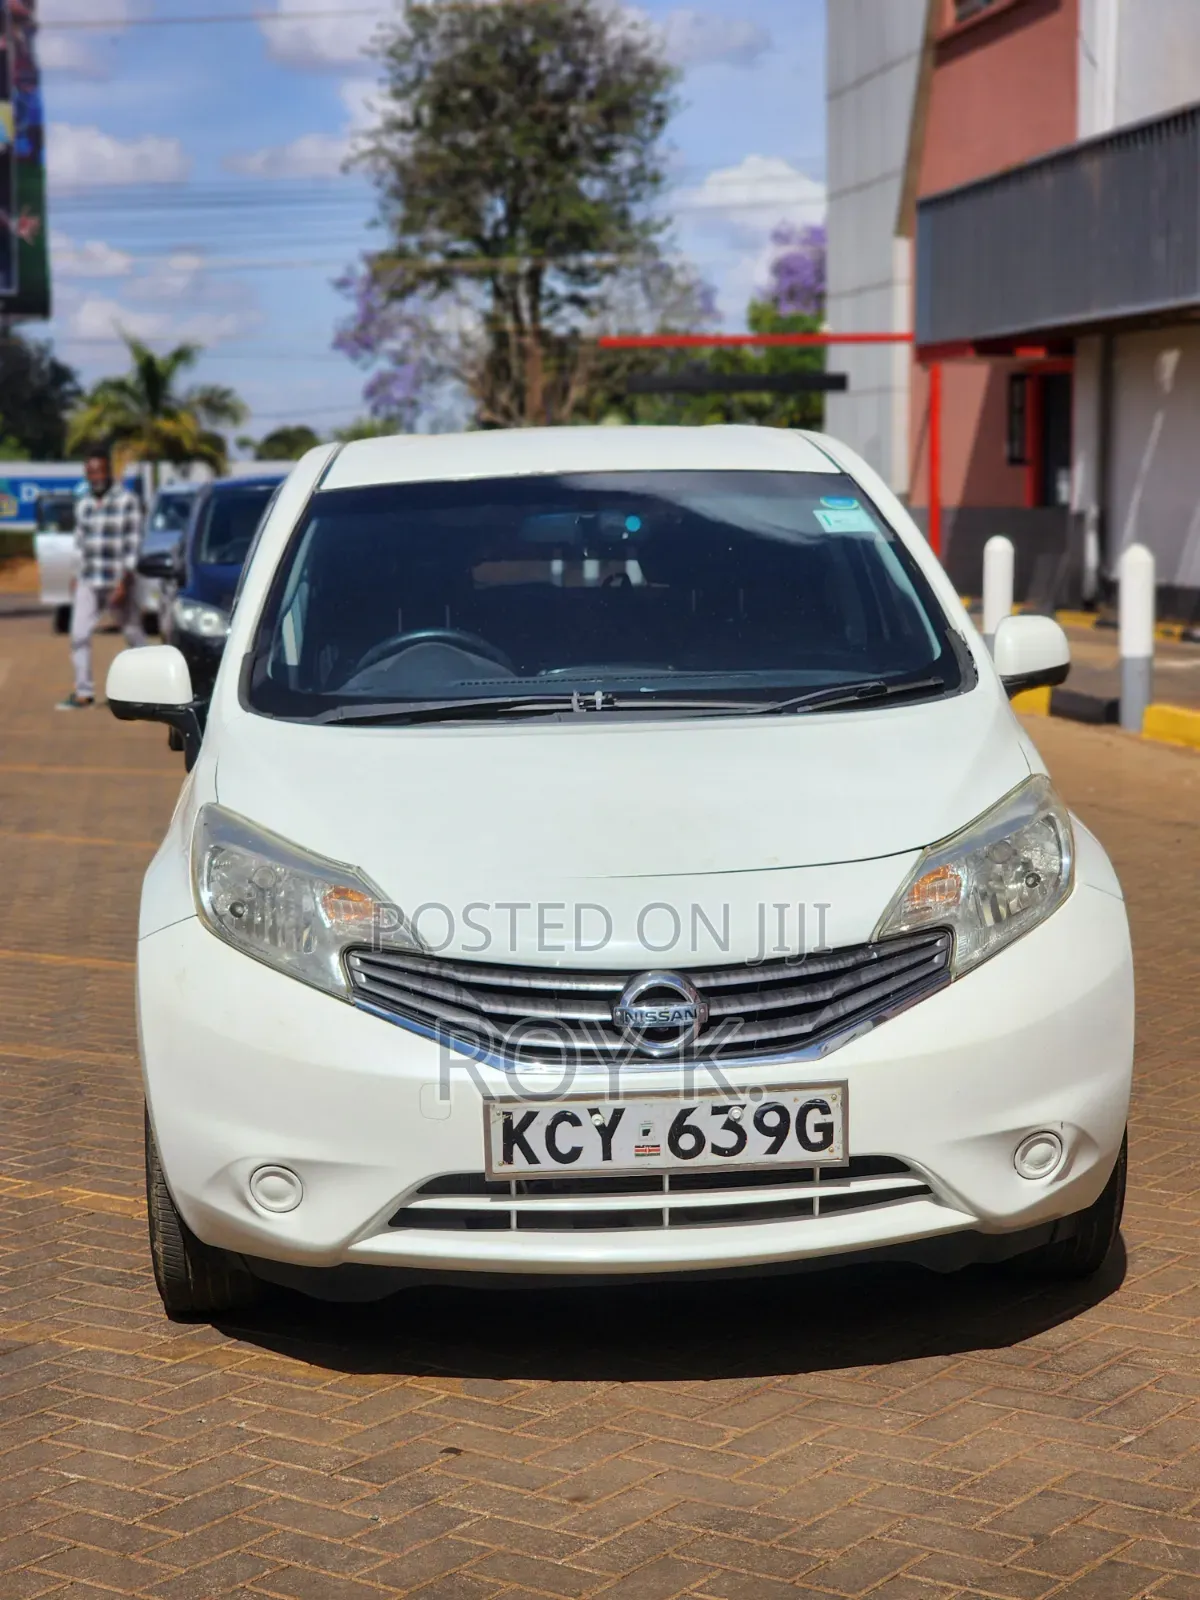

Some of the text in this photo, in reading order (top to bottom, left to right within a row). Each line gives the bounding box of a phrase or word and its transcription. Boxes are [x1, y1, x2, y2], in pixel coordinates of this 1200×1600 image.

[623, 1008, 698, 1024] NISSAN
[501, 1098, 834, 1167] KCY 639G
